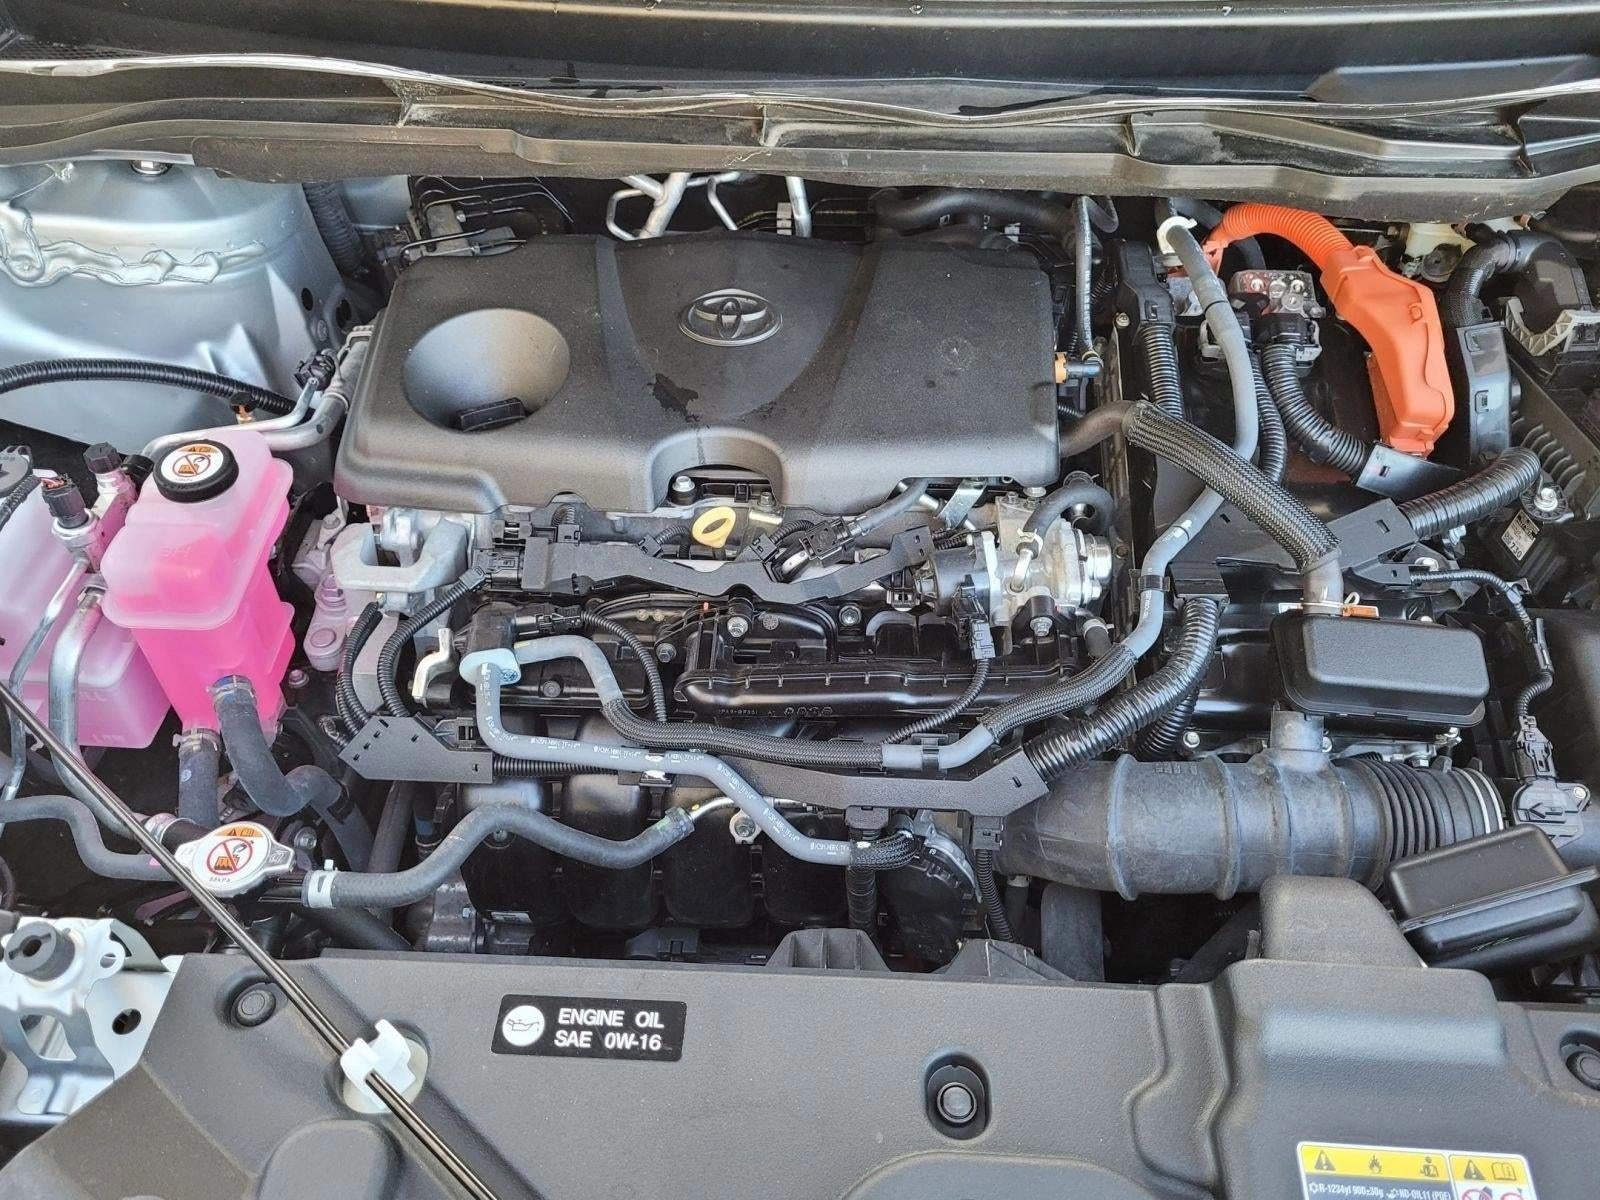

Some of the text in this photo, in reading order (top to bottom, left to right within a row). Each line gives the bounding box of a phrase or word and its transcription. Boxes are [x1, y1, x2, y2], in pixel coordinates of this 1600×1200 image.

[557, 1007, 665, 1029] ENGINE OIL
[553, 1030, 662, 1051] SAE 0W-16
